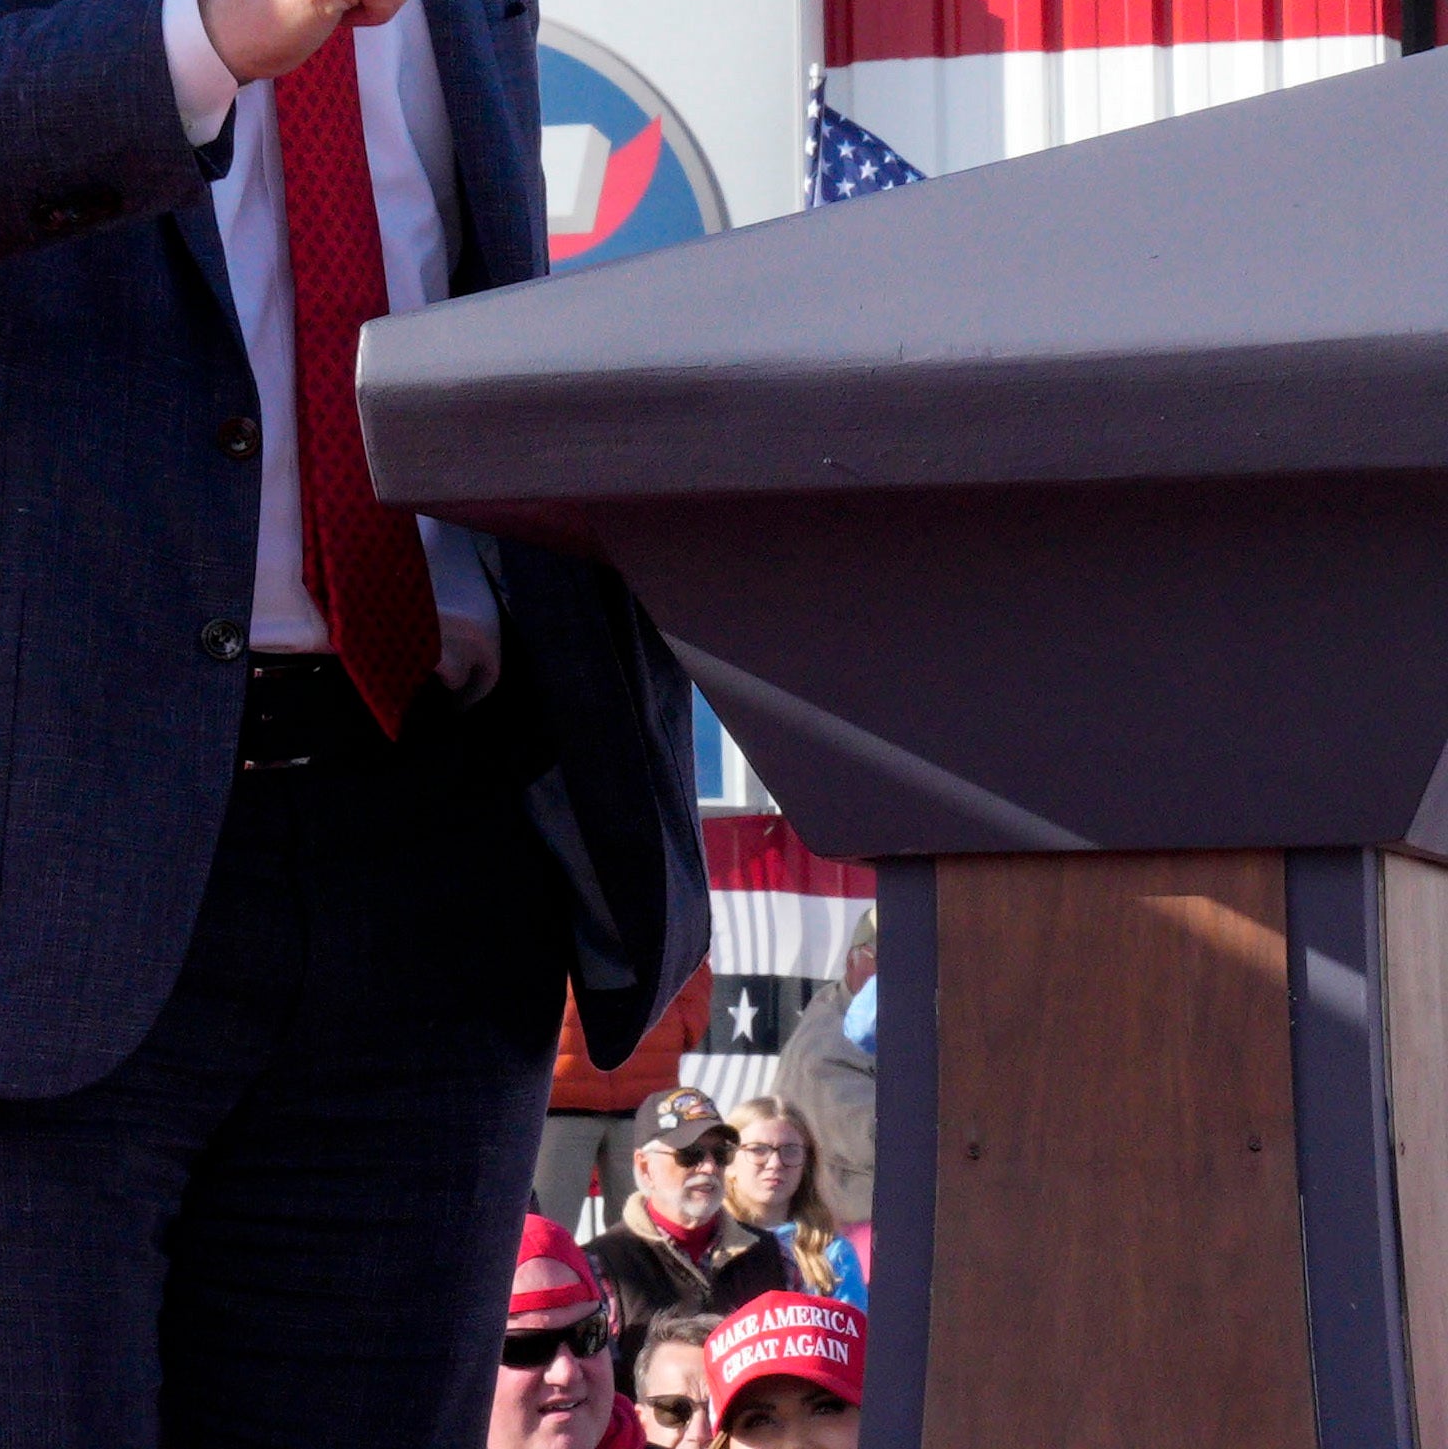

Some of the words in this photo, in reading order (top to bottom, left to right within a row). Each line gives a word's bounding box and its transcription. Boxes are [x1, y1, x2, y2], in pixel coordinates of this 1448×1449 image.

[709, 1314, 759, 1363] MAKE
[761, 1305, 860, 1338] AMERICA
[722, 1337, 779, 1384] GREAT
[783, 1334, 849, 1366] AGAIN
